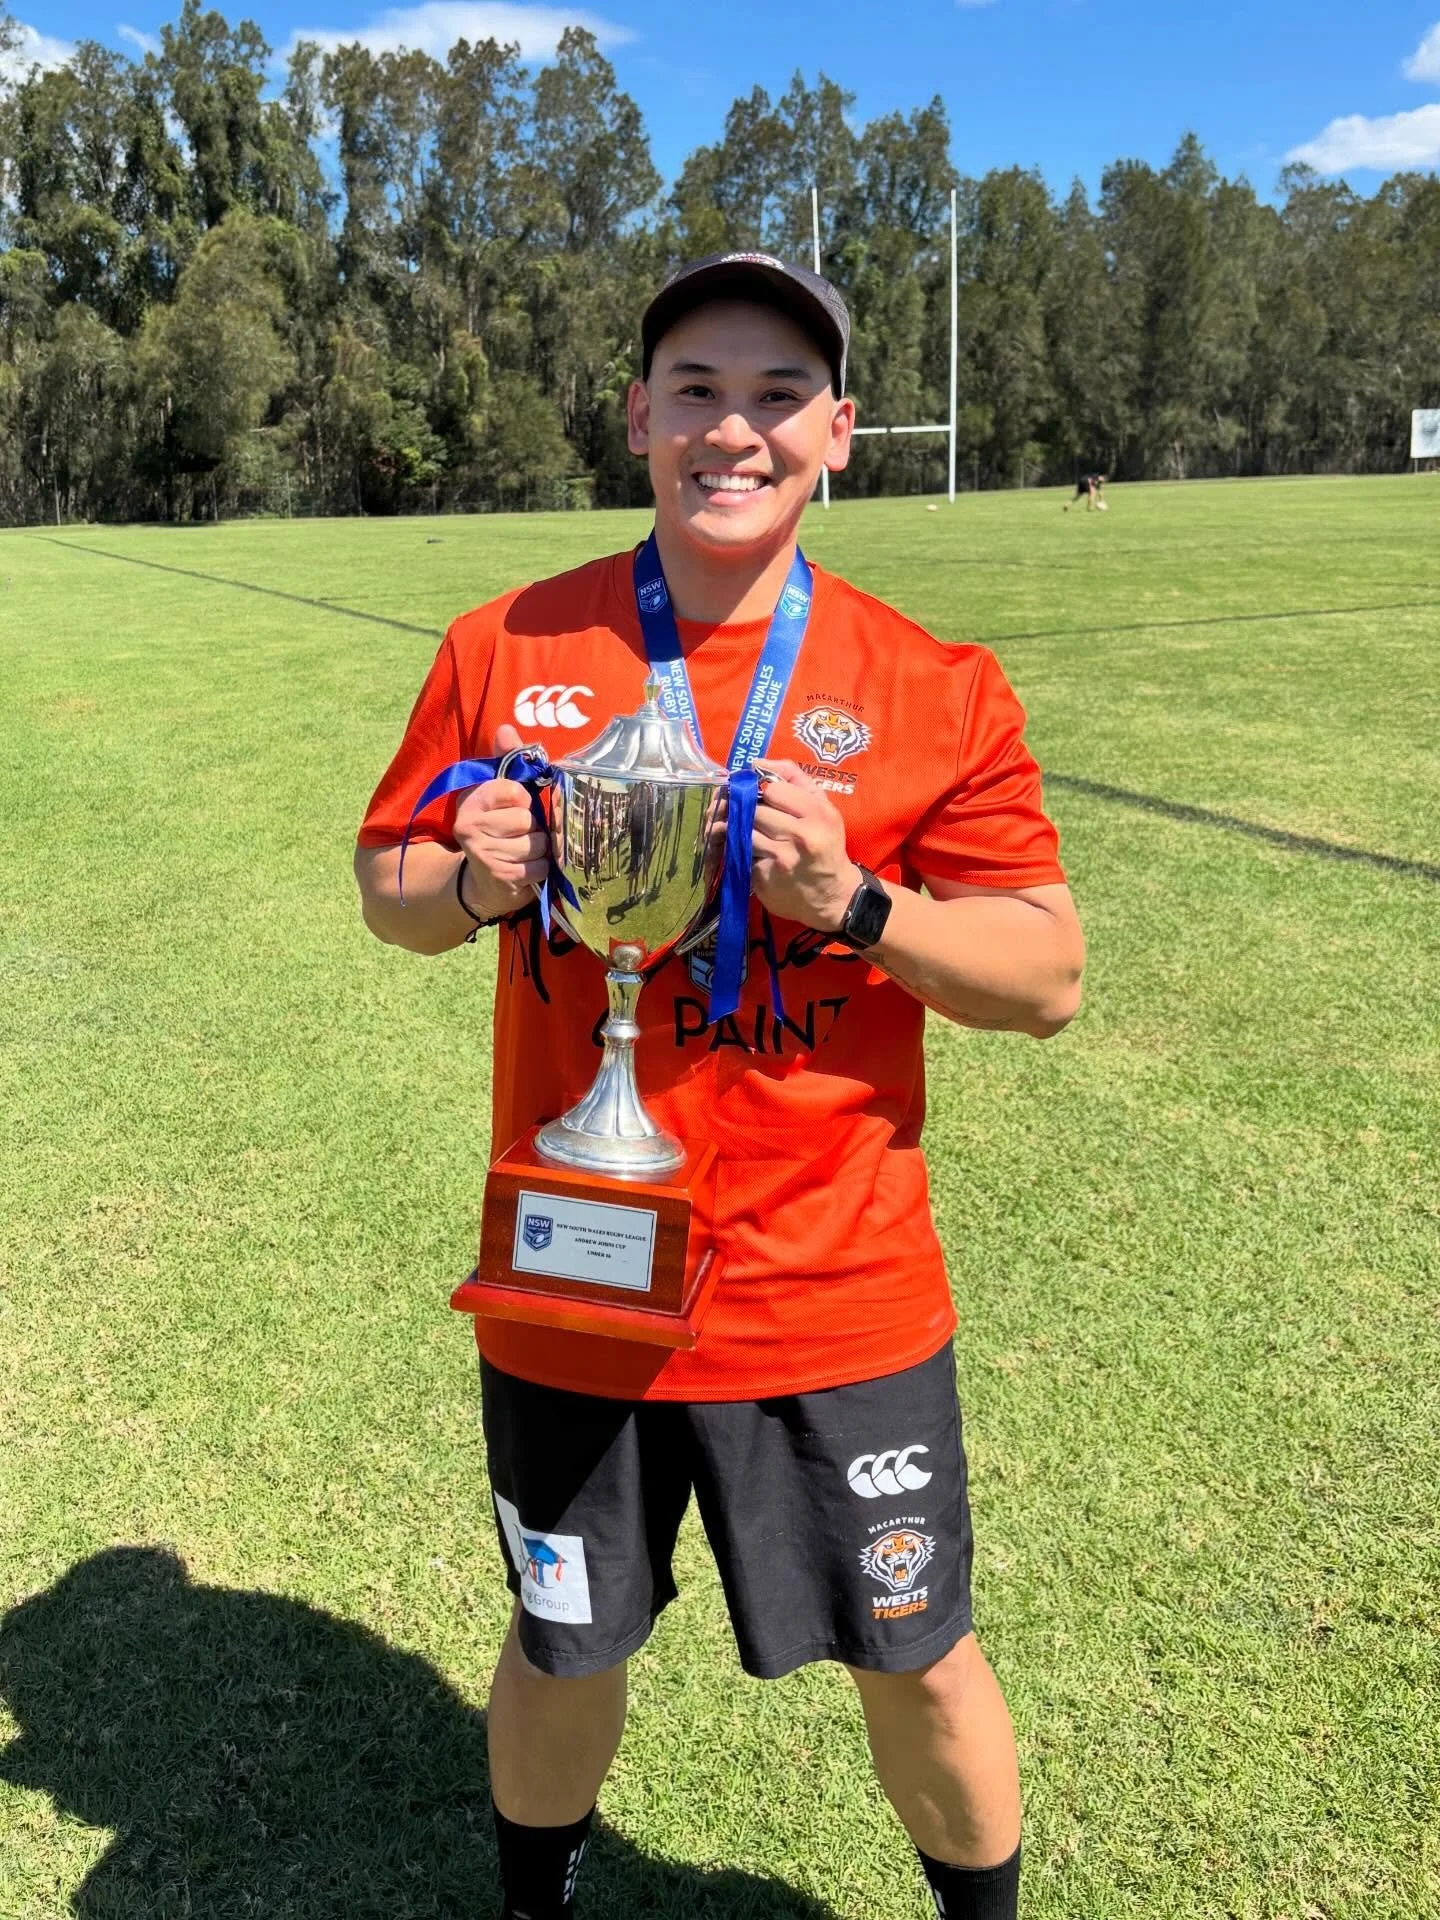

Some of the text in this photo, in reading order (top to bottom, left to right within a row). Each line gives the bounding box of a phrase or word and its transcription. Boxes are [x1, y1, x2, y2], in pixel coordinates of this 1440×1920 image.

[640, 580, 661, 596] NSW
[669, 659, 686, 687] NEW
[660, 675, 679, 714] RUGBY
[806, 693, 865, 713] MACARTHUR
[675, 689, 695, 730] SOUT
[730, 664, 774, 773] NEW SOUTH WALES
[746, 680, 783, 763] RUGBY LEAGUE
[673, 994, 852, 1055] PAINT
[527, 1217, 550, 1229] NSW
[569, 1225, 587, 1233] SOUTH
[588, 1227, 605, 1235] WALES
[606, 1230, 624, 1238] RUGBY
[625, 1233, 646, 1242] LEAGUE
[575, 1237, 597, 1245] ANDREW
[587, 1250, 605, 1258] UNDER
[867, 1516, 926, 1535] MACARTHUR
[534, 1593, 570, 1613] Group
[872, 1586, 928, 1608] WESTS
[872, 1599, 928, 1620] TIGERS
